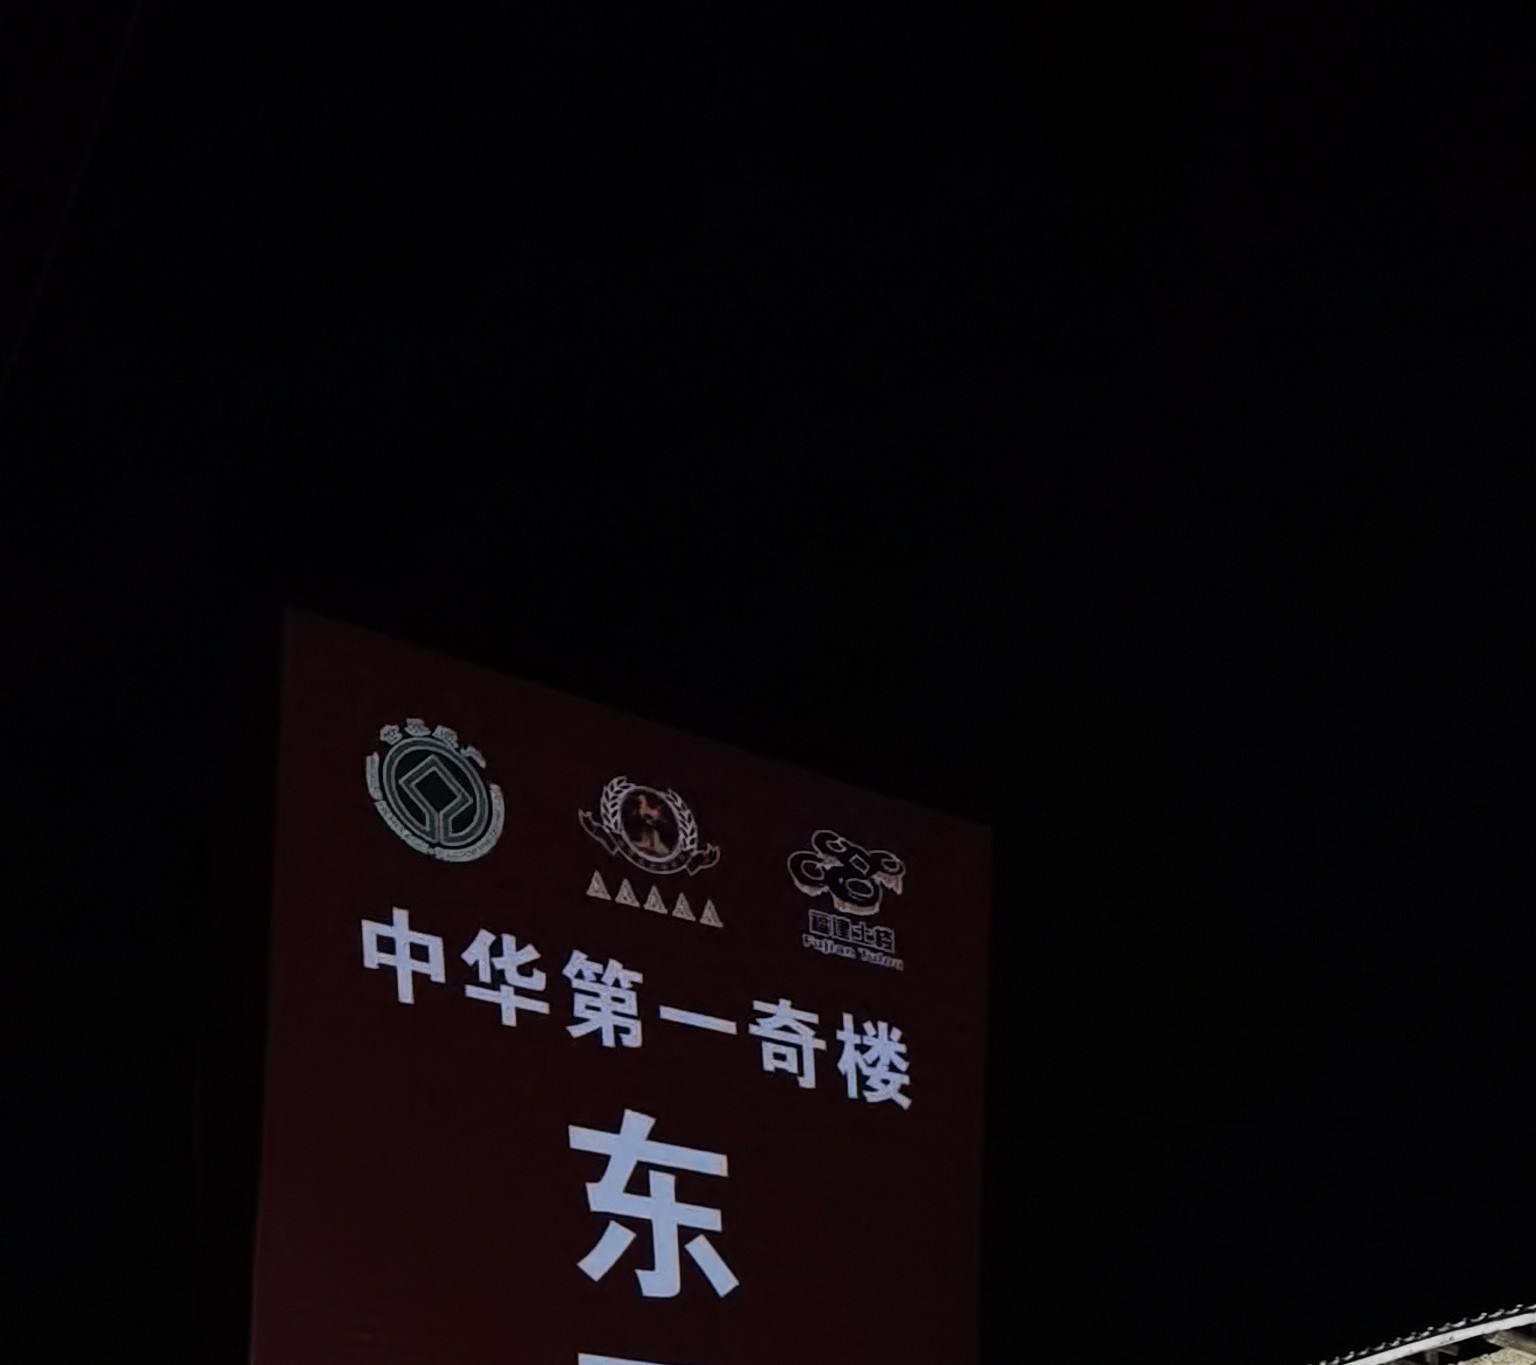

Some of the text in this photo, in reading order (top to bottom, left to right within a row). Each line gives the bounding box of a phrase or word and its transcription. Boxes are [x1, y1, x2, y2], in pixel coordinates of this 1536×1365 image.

[360, 906, 913, 1109] 中华第一奇楼
